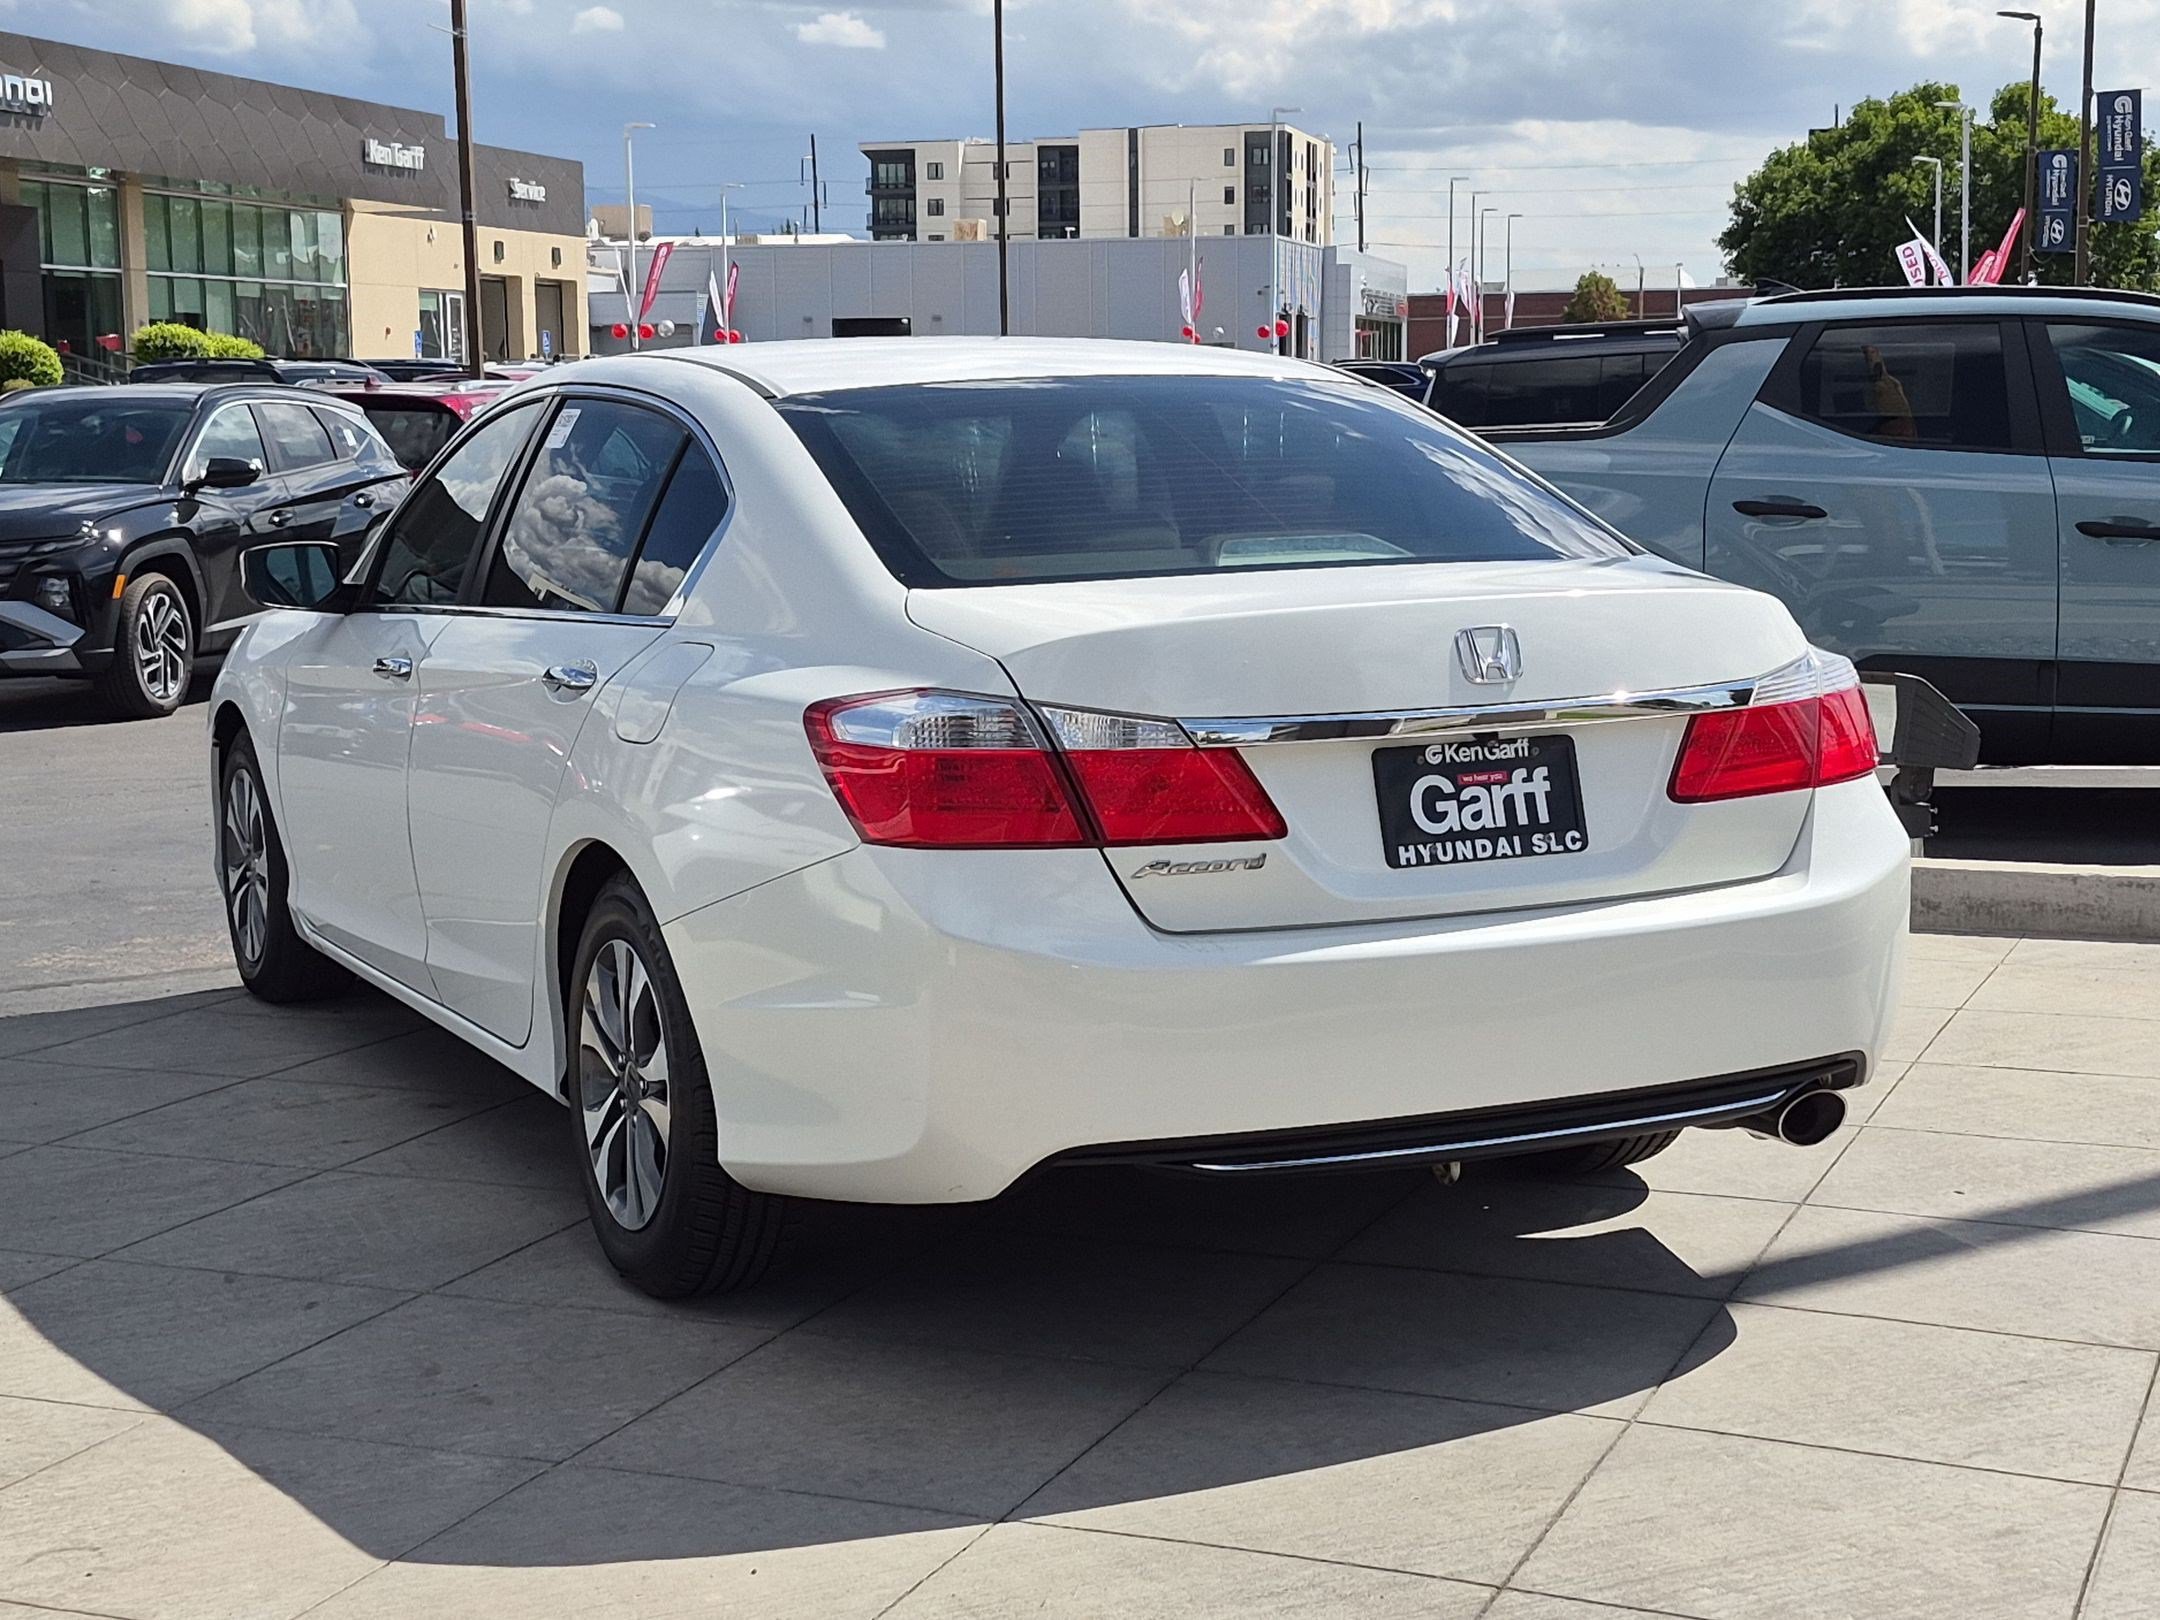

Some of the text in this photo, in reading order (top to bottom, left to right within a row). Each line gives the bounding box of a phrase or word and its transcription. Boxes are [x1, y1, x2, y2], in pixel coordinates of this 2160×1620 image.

[2113, 115, 2124, 161] Hyundai
[365, 139, 424, 170] Ken Garff
[508, 178, 546, 202] Service
[1444, 743, 1484, 763] Ken
[1484, 738, 1530, 761] Garff
[1410, 766, 1551, 834] Garff
[1398, 829, 1583, 866] HYUNDAI SLC
[1131, 852, 1267, 878] Accord
